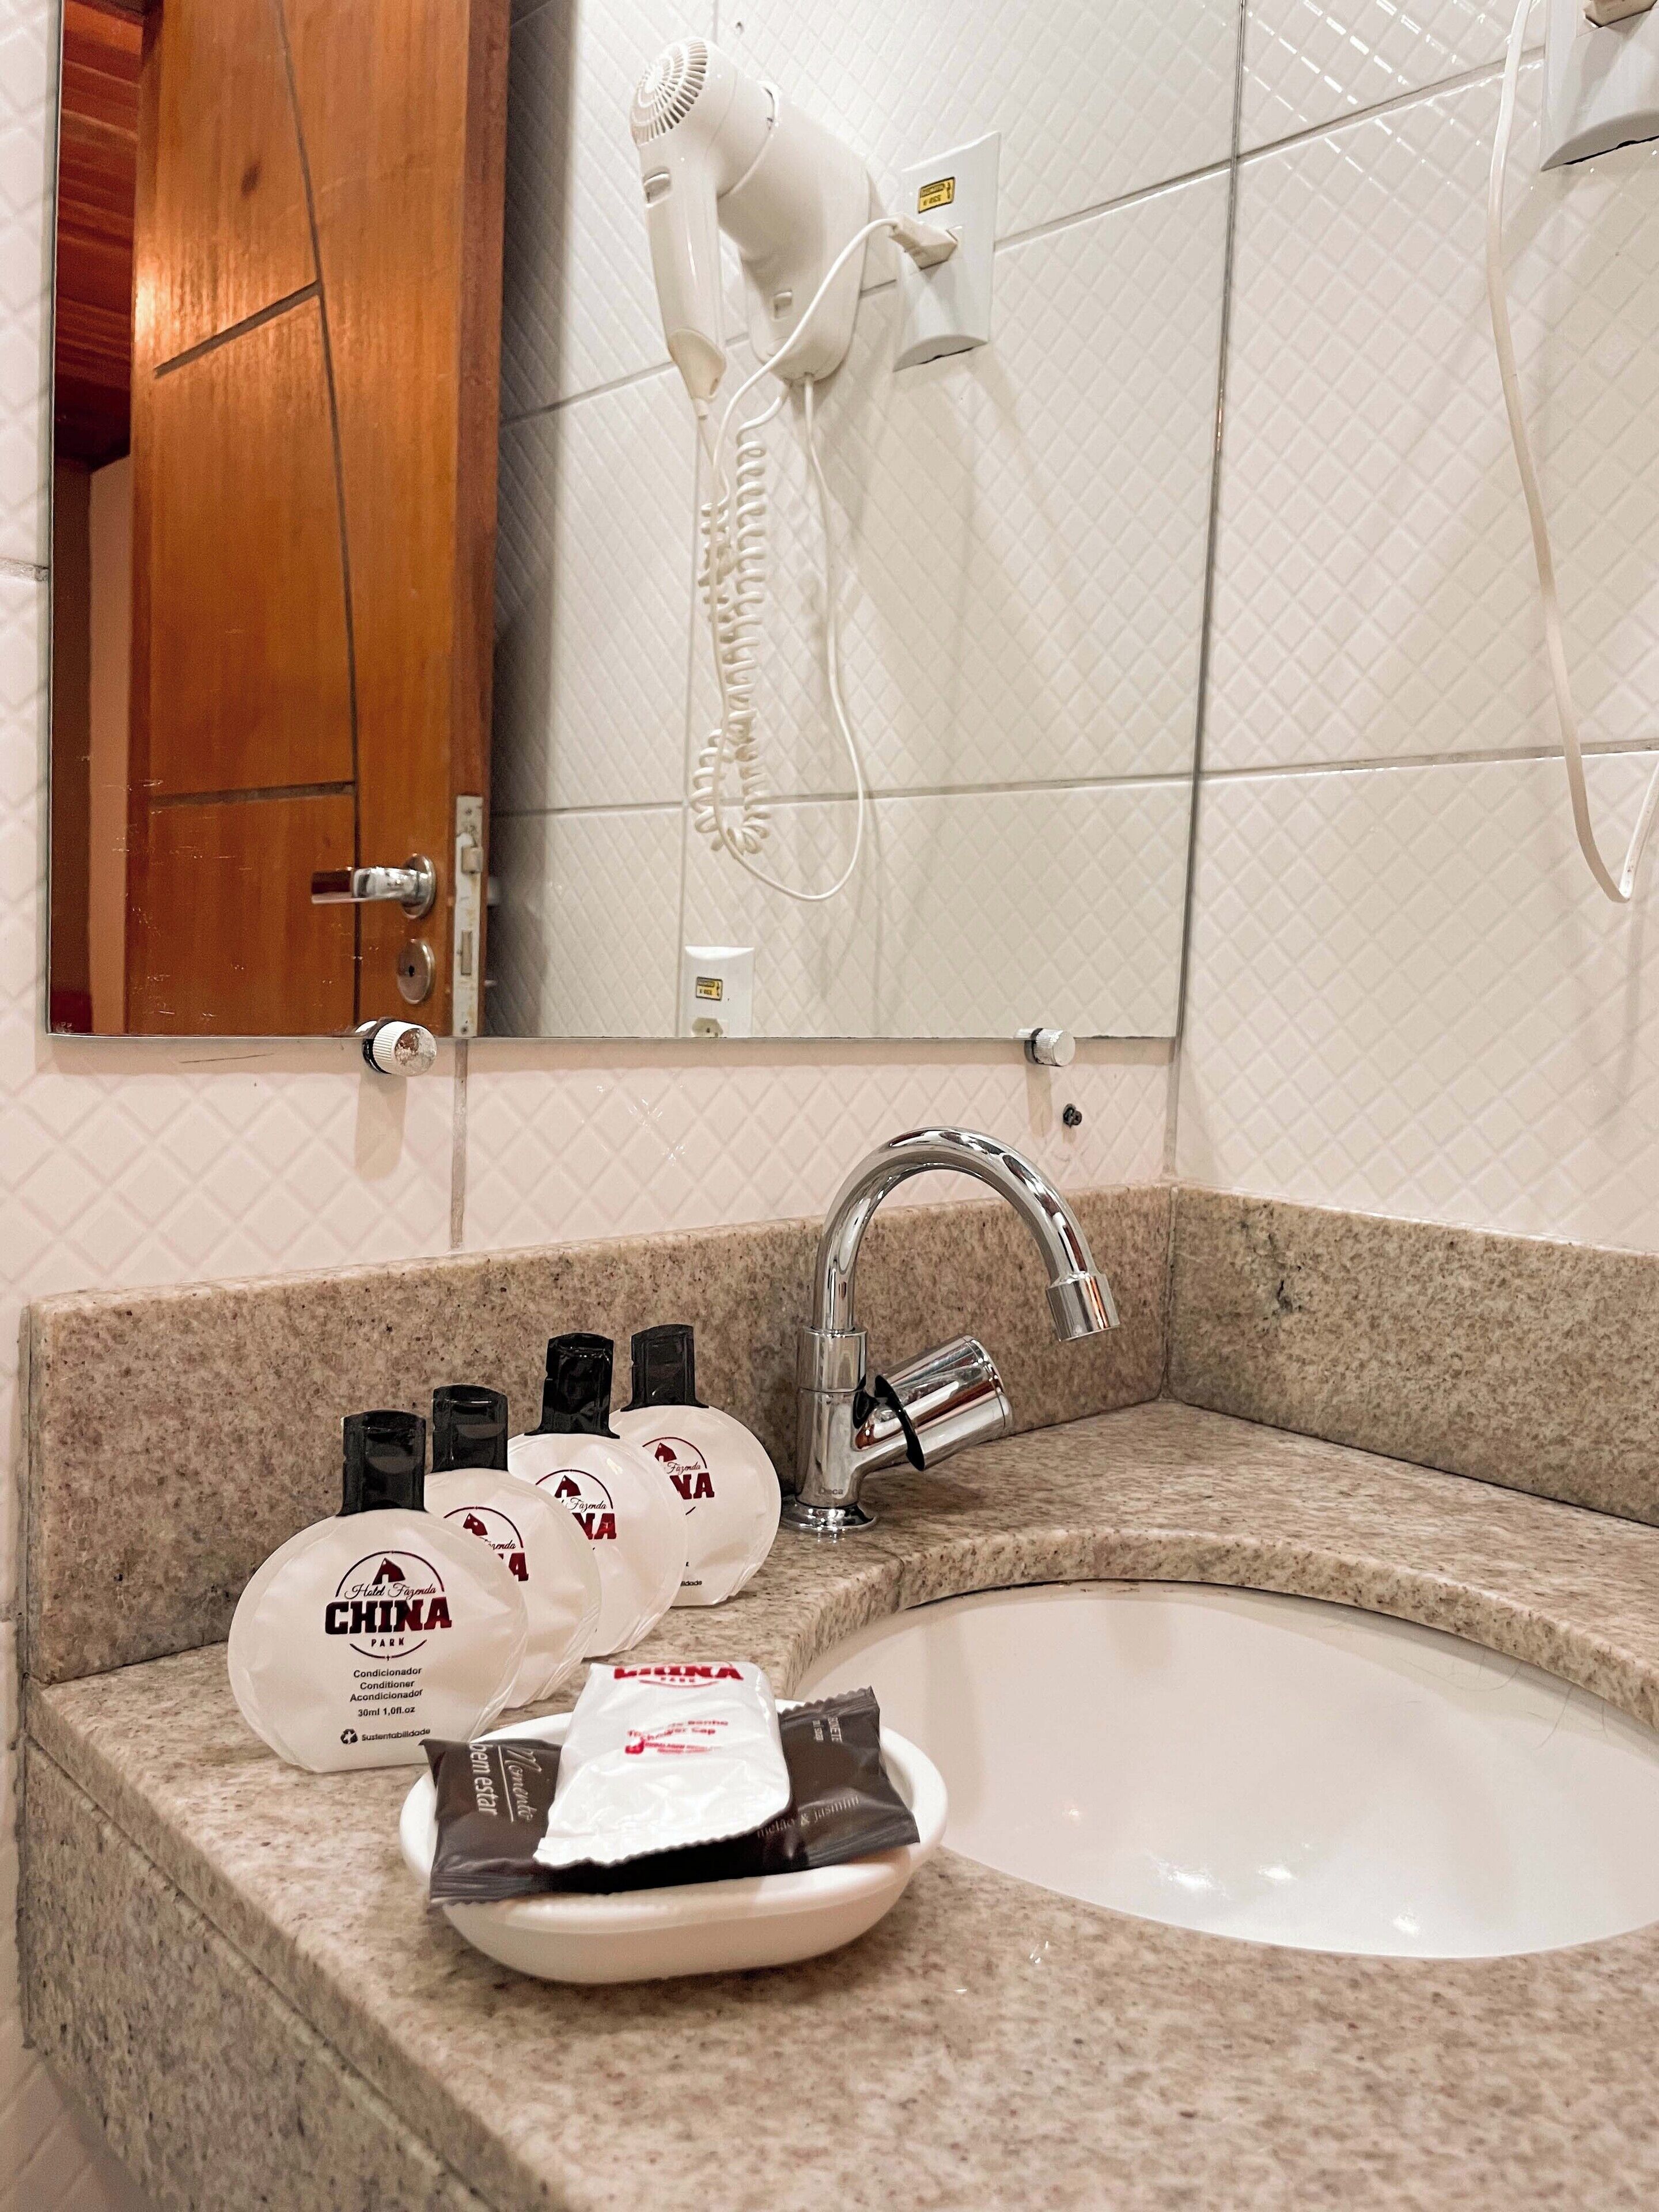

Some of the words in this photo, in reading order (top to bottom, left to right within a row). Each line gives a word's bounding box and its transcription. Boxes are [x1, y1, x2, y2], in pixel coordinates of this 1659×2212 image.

[664, 1461, 701, 1475] Fazenda
[566, 1497, 607, 1513] Fazenda
[344, 1583, 385, 1599] Hotel
[388, 1582, 436, 1600] Fazenda
[325, 1597, 452, 1635] CHINA
[371, 1637, 404, 1647] PARK
[353, 1667, 422, 1678] Condicionador
[360, 1680, 415, 1690] Conditioner
[350, 1689, 423, 1702] Acondicionador
[358, 1708, 380, 1717] 30ml
[362, 1728, 430, 1741] Sustentabilidade
[469, 1744, 494, 1774] bem
[505, 1749, 542, 1821] Momento
[474, 1777, 499, 1816] estar
